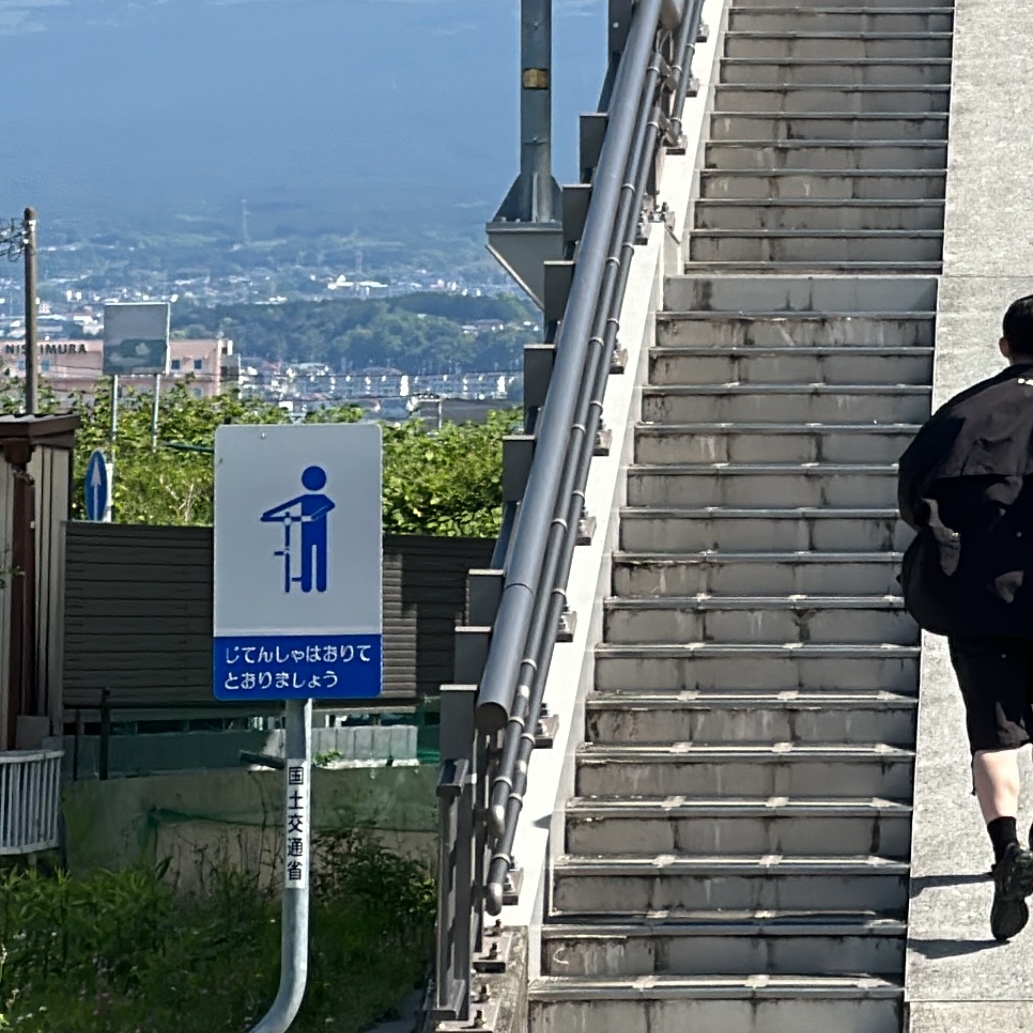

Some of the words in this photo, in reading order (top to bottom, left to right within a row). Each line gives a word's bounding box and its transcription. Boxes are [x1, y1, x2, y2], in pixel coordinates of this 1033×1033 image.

[5, 343, 87, 355] NISIMURA
[225, 644, 372, 665] じてんしゃはおりて
[224, 670, 339, 691] とおりましょう
[288, 766, 304, 881] 国土交通省
